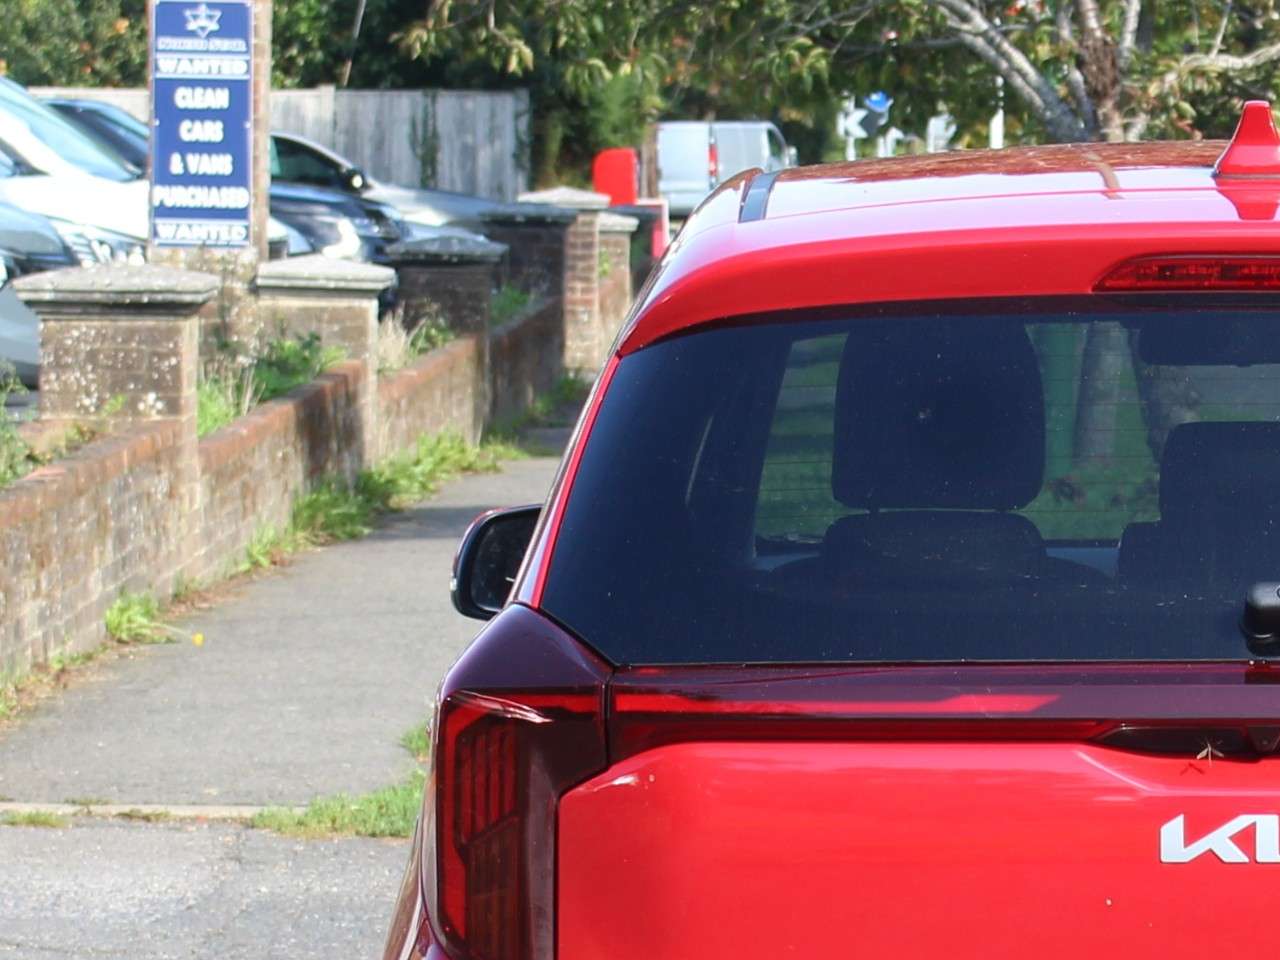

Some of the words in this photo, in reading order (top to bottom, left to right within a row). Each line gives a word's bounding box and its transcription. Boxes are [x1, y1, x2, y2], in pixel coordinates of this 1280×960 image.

[157, 58, 248, 75] WANTED
[174, 86, 230, 110] CLEAN
[179, 119, 224, 142] CARS
[169, 152, 184, 175] &
[186, 153, 233, 176] VANS
[153, 185, 249, 209] PURCHASED
[155, 223, 248, 241] WANTED
